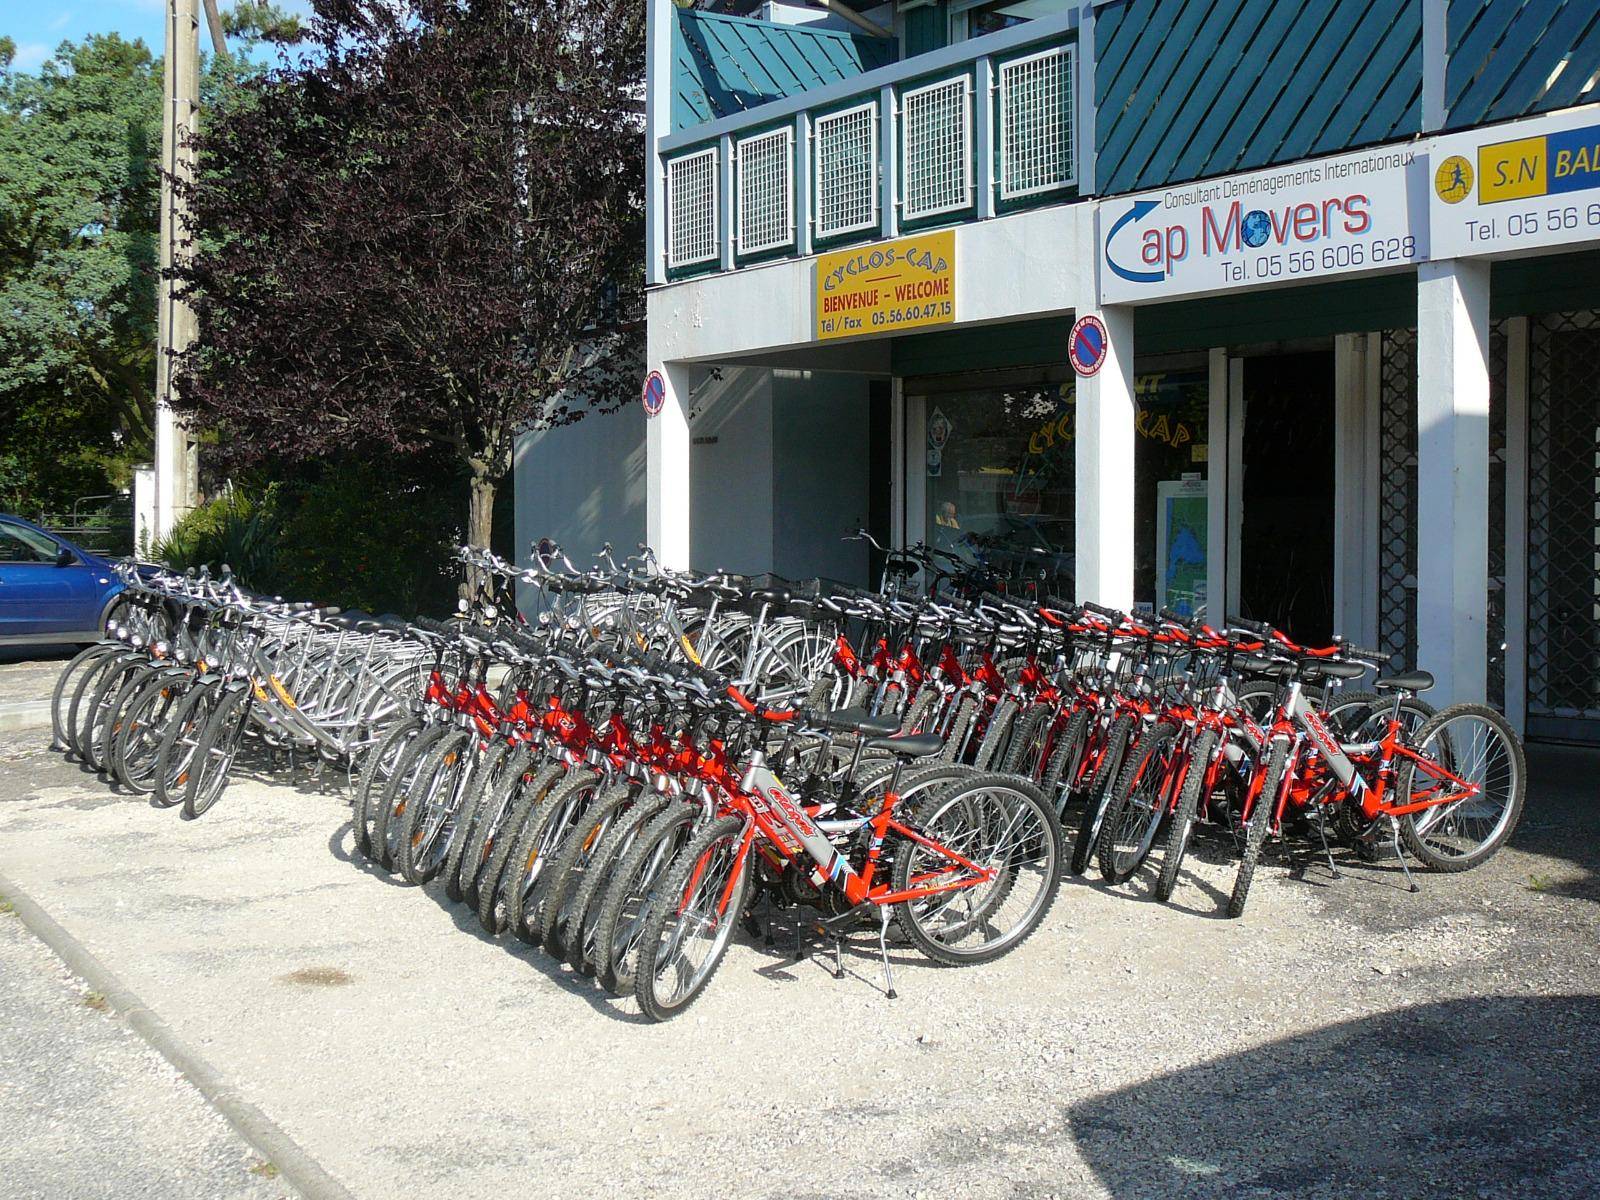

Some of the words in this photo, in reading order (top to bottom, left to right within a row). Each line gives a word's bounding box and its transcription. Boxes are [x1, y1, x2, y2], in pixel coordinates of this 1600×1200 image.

[1164, 186, 1221, 209] Consultant
[1223, 167, 1321, 199] Déménagements
[1323, 151, 1416, 181] Internationaux
[1493, 156, 1537, 187] S.N
[1465, 218, 1501, 242] Tel.
[1507, 212, 1538, 237] 05
[1547, 207, 1578, 231] 56
[823, 247, 948, 292] CYCLOS-CAP
[1221, 261, 1250, 283] Tel.
[1256, 254, 1282, 278] 05
[1289, 250, 1315, 274] 56
[1322, 243, 1364, 269] 606
[1371, 235, 1417, 261] 628
[823, 289, 879, 314] BIENVENUE
[894, 277, 949, 303] WELCOME
